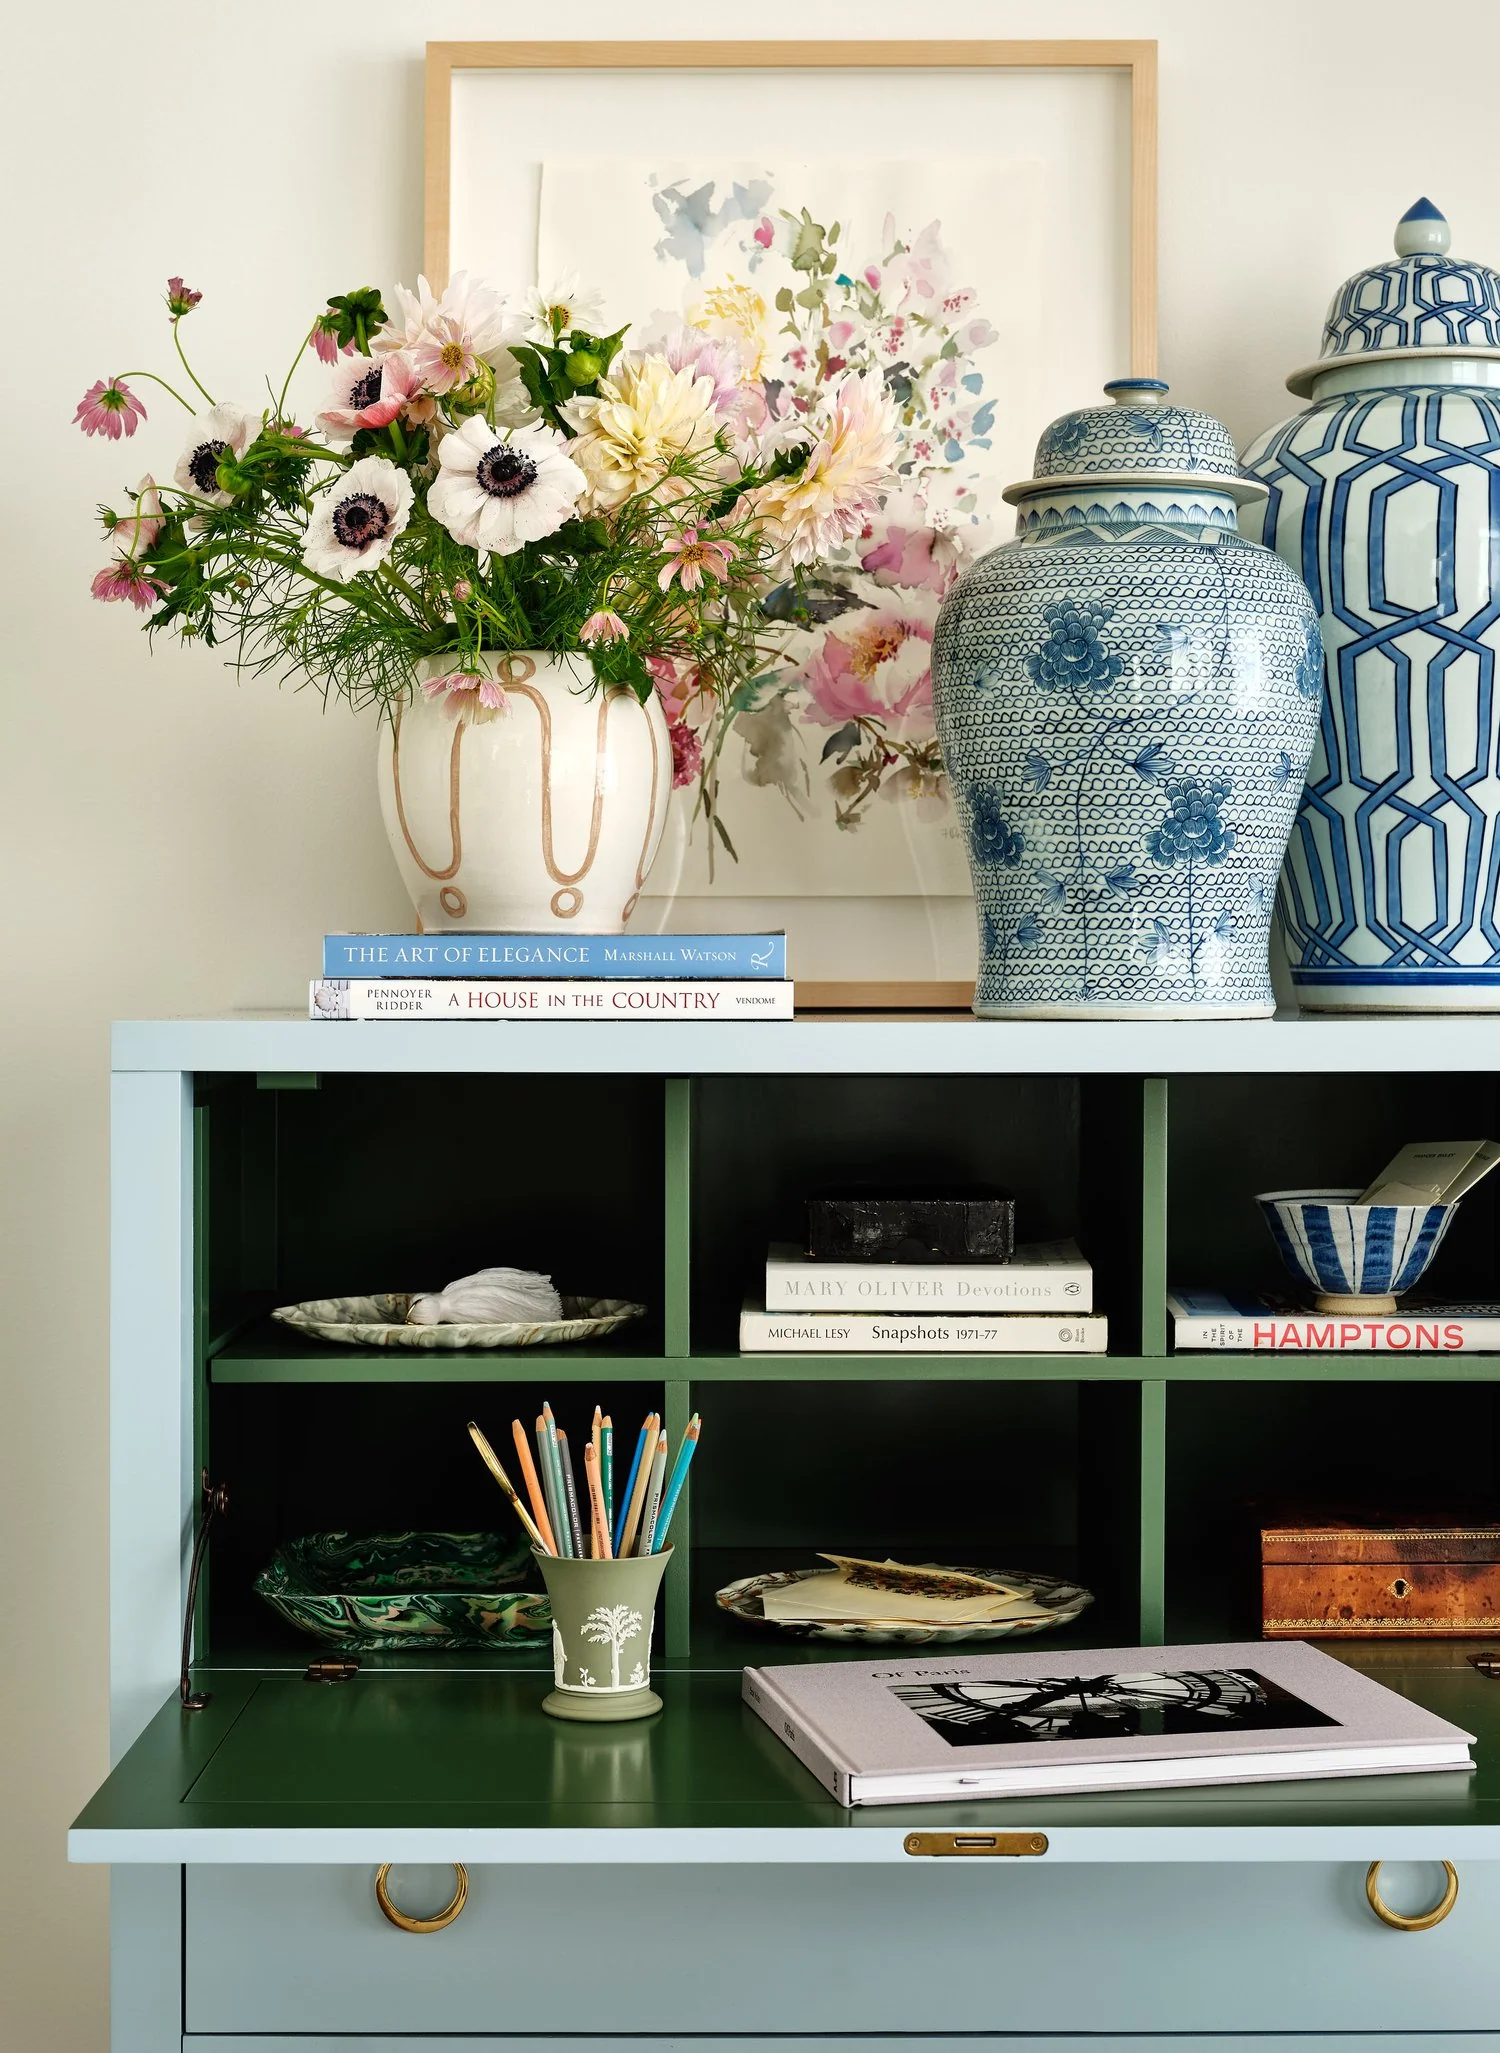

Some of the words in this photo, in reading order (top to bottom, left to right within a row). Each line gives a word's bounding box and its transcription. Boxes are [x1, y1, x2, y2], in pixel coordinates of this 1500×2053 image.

[344, 947, 388, 963] THE
[395, 947, 439, 963] ART
[443, 947, 472, 963] OF
[478, 947, 590, 963] ELEGANCE
[604, 948, 677, 962] MARSHALL
[681, 948, 737, 962] WATSON
[367, 988, 433, 999] PENNOYER
[447, 992, 460, 1007] A
[468, 991, 539, 1009] HOUSE
[548, 994, 566, 1007] IN
[572, 994, 604, 1007] THE
[611, 991, 721, 1010] COUNTRY
[735, 997, 776, 1005] VENDOME
[376, 1000, 423, 1011] RIDDER
[785, 1280, 847, 1297] MARY
[857, 1280, 944, 1297] OLIVER
[957, 1281, 1052, 1297] Devotions
[767, 1327, 822, 1339] MICHAEL
[825, 1328, 851, 1339] LESY
[871, 1324, 950, 1344] Snapshots
[1202, 1330, 1208, 1339] IN
[1228, 1329, 1235, 1341] OF
[1253, 1322, 1464, 1350] HAMPTONS
[565, 1474, 579, 1529] PRISMACOLOR
[646, 1492, 660, 1545] PRISMACOLOR
[911, 1668, 971, 1677] Paris
